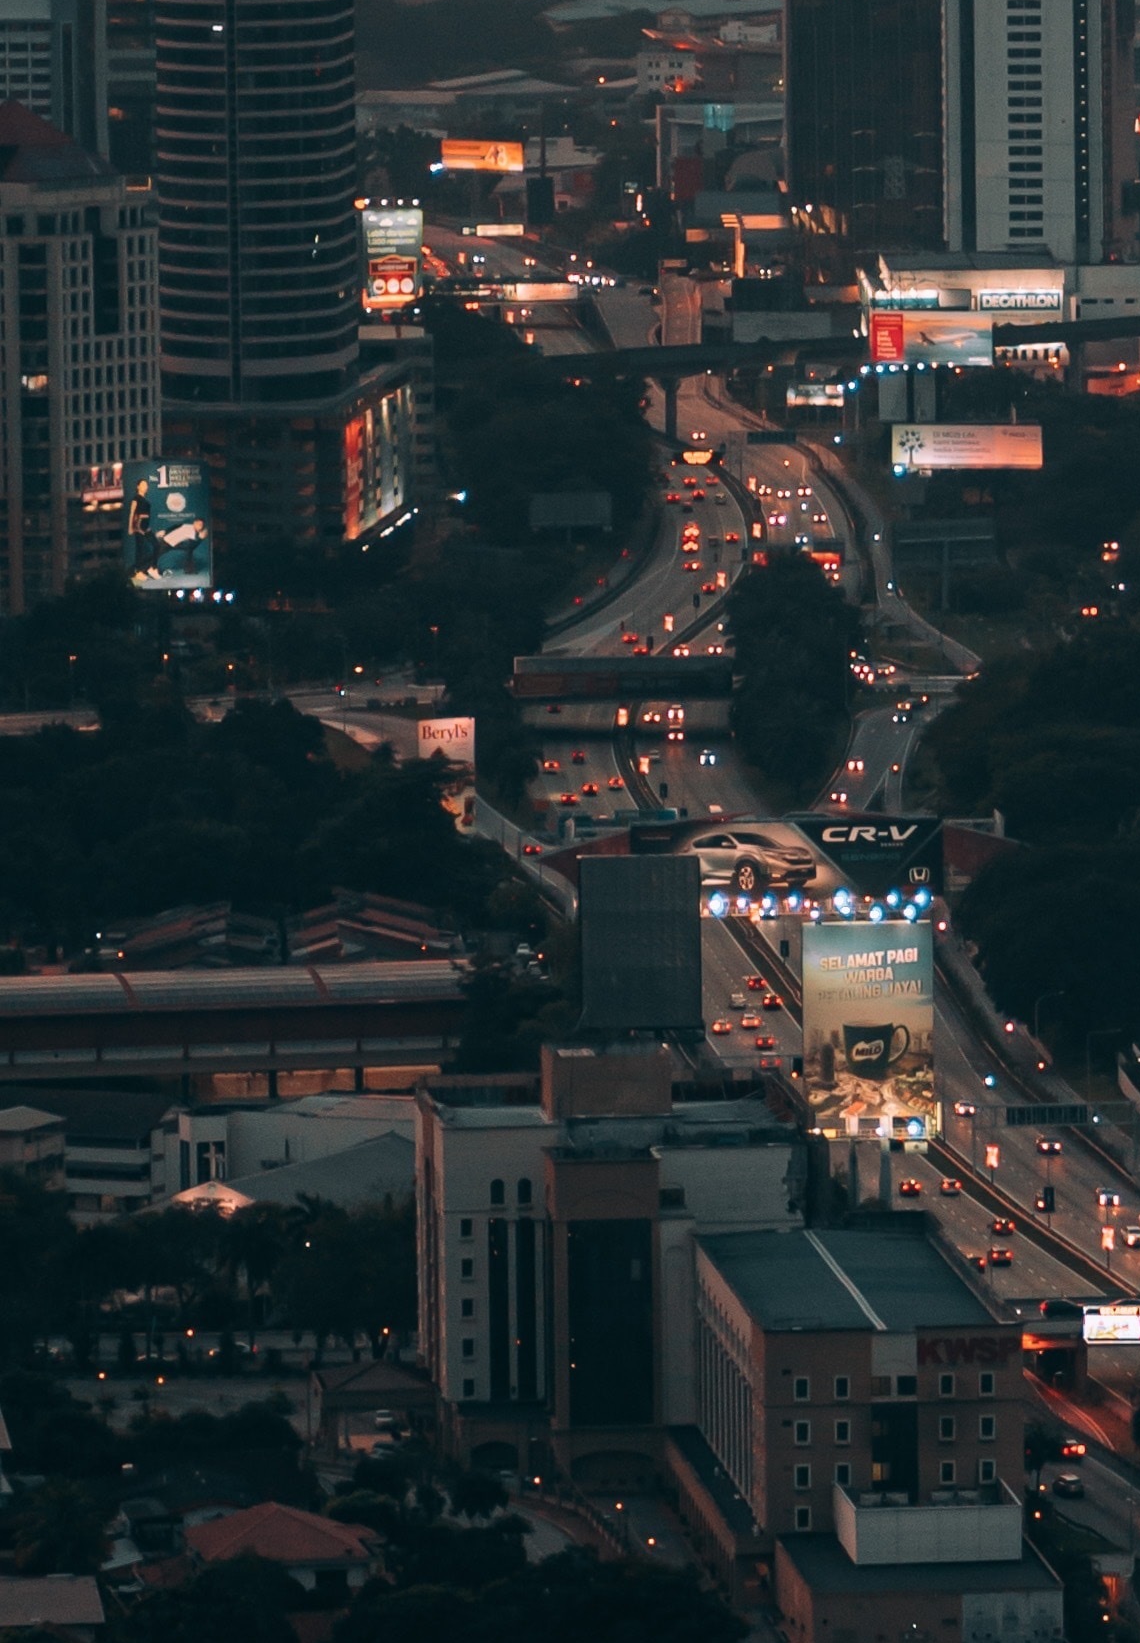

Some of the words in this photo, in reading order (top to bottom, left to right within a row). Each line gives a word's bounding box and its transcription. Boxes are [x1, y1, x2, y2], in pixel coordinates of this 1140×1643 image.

[982, 294, 1058, 308] DECATHLON
[157, 465, 169, 488] 1
[422, 724, 468, 743] Beryl's
[822, 825, 918, 843] CR-V
[820, 951, 885, 971] SELAMAT
[887, 947, 918, 964] PAGI
[844, 967, 894, 984] WARGA
[888, 980, 922, 996] JAYA!
[855, 1044, 882, 1056] MILO
[917, 1337, 1018, 1366] KWSP
